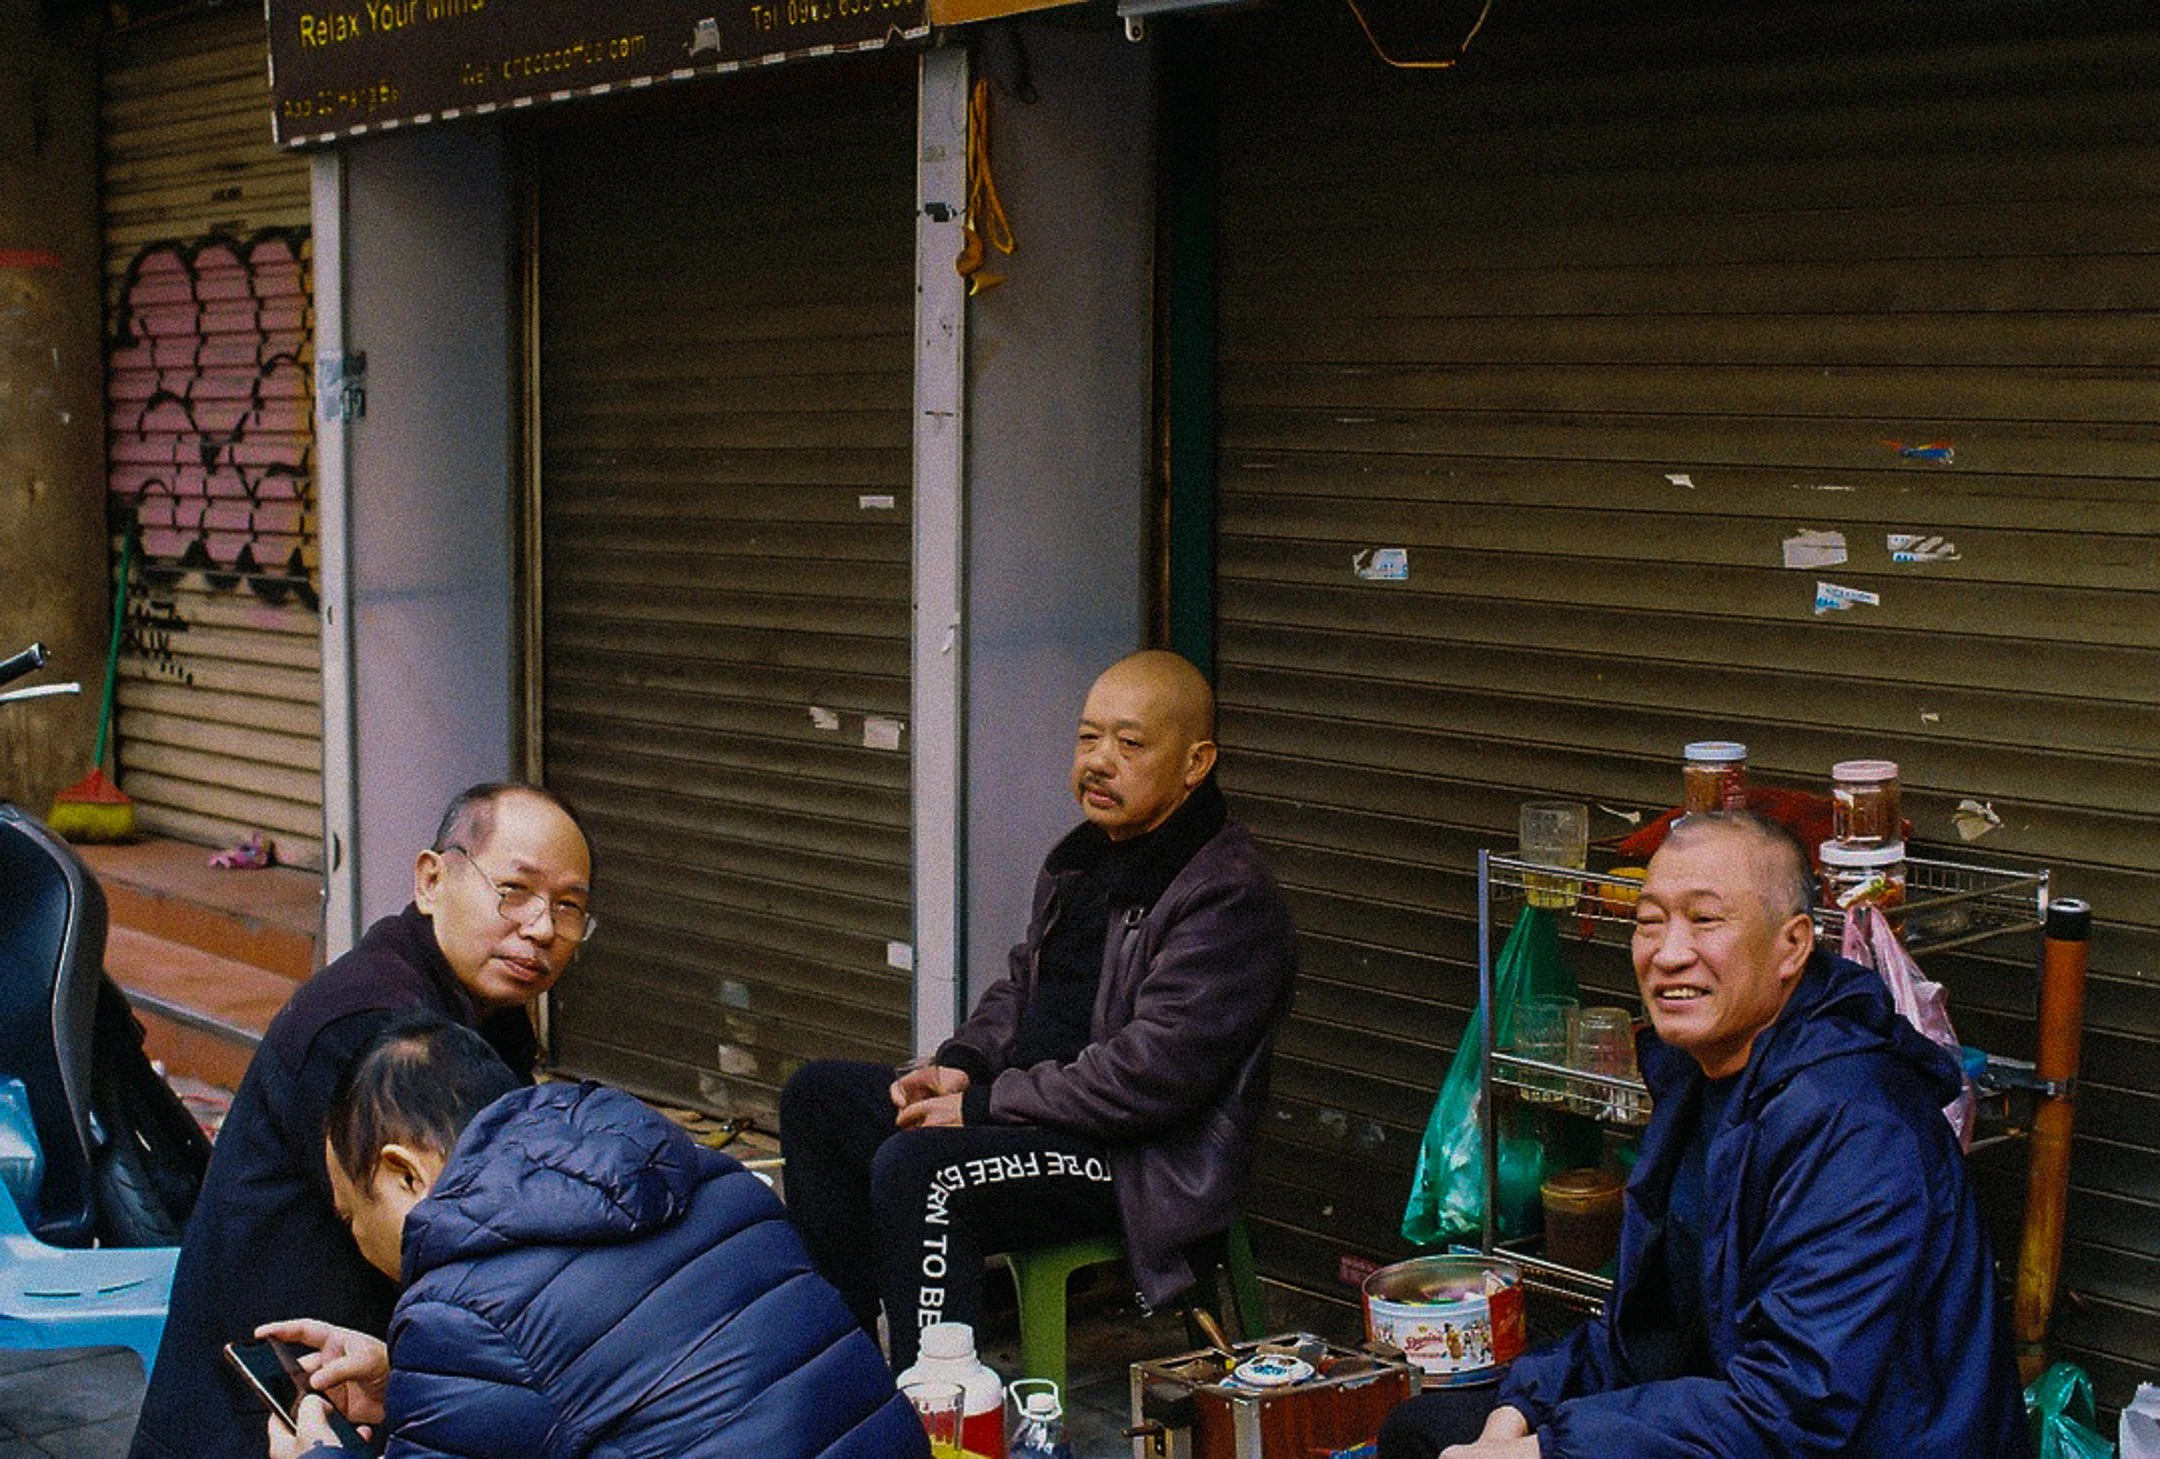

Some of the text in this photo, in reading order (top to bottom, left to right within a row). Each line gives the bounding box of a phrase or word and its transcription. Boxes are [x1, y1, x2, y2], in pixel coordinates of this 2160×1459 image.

[300, 11, 360, 47] Relax
[366, 0, 417, 32] Your
[965, 1151, 1041, 1186] FREE
[922, 1234, 947, 1278] TO
[917, 1287, 945, 1328] BE
